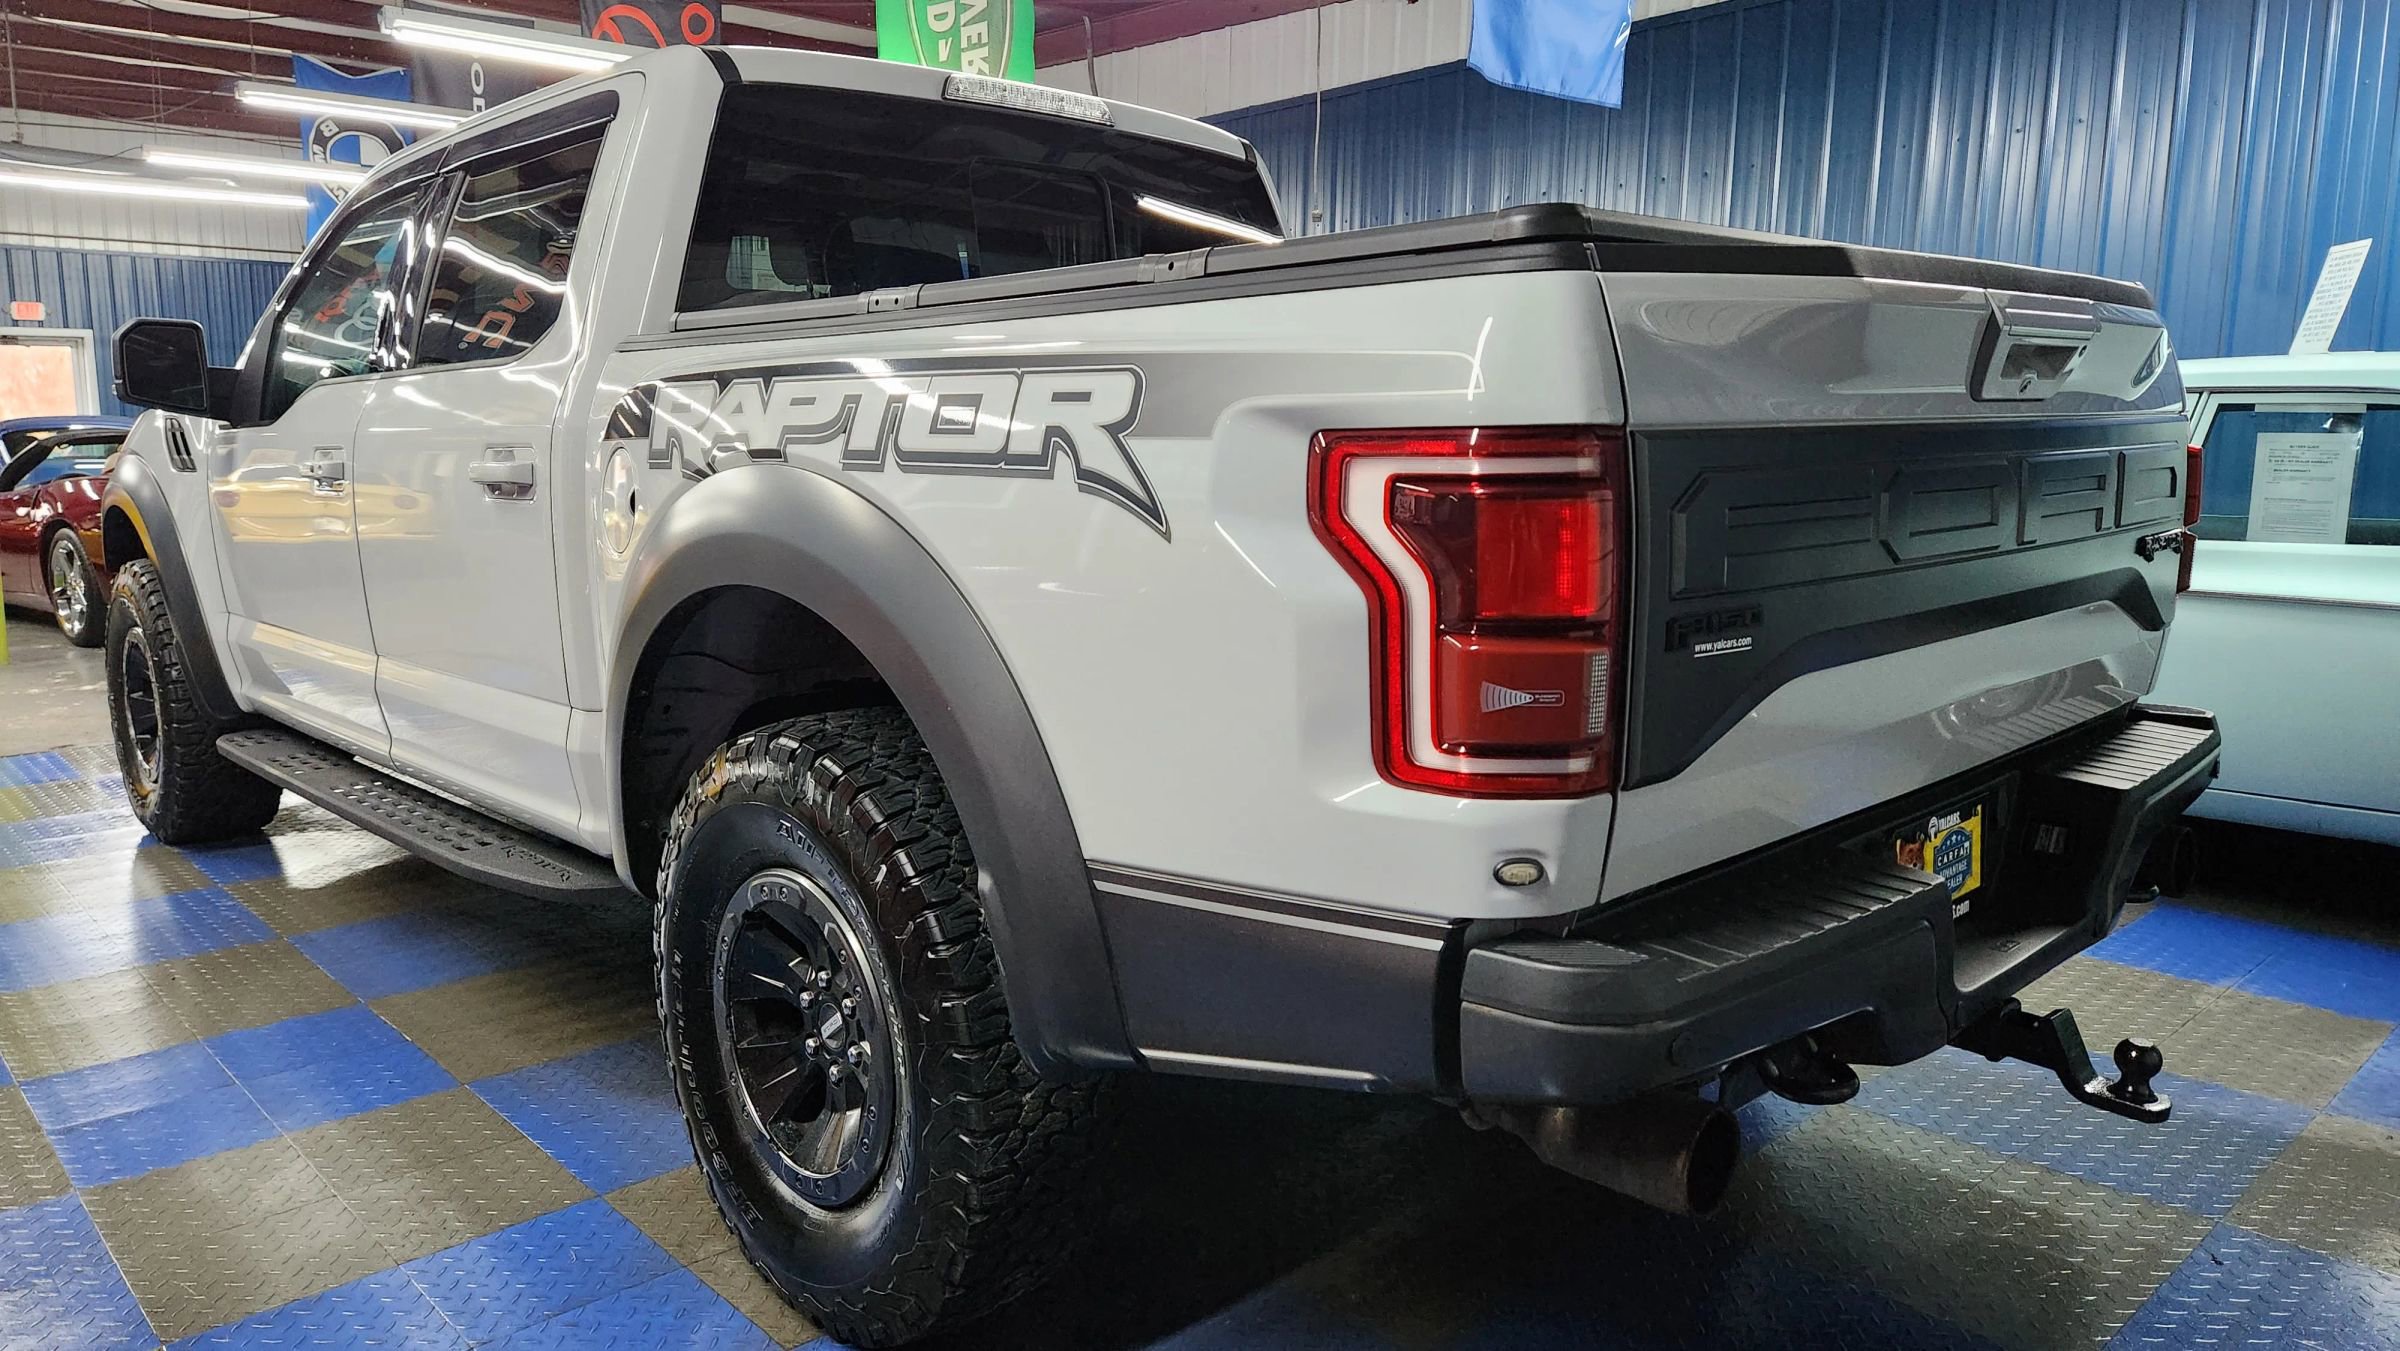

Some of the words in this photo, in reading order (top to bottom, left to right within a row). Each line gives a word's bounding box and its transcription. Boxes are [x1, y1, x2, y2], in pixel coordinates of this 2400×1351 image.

[646, 364, 1172, 543] RAPTOR
[1668, 441, 2183, 600] FORD
[1694, 636, 1752, 653] www.yalcars.com
[1937, 841, 1970, 867] CARFAX
